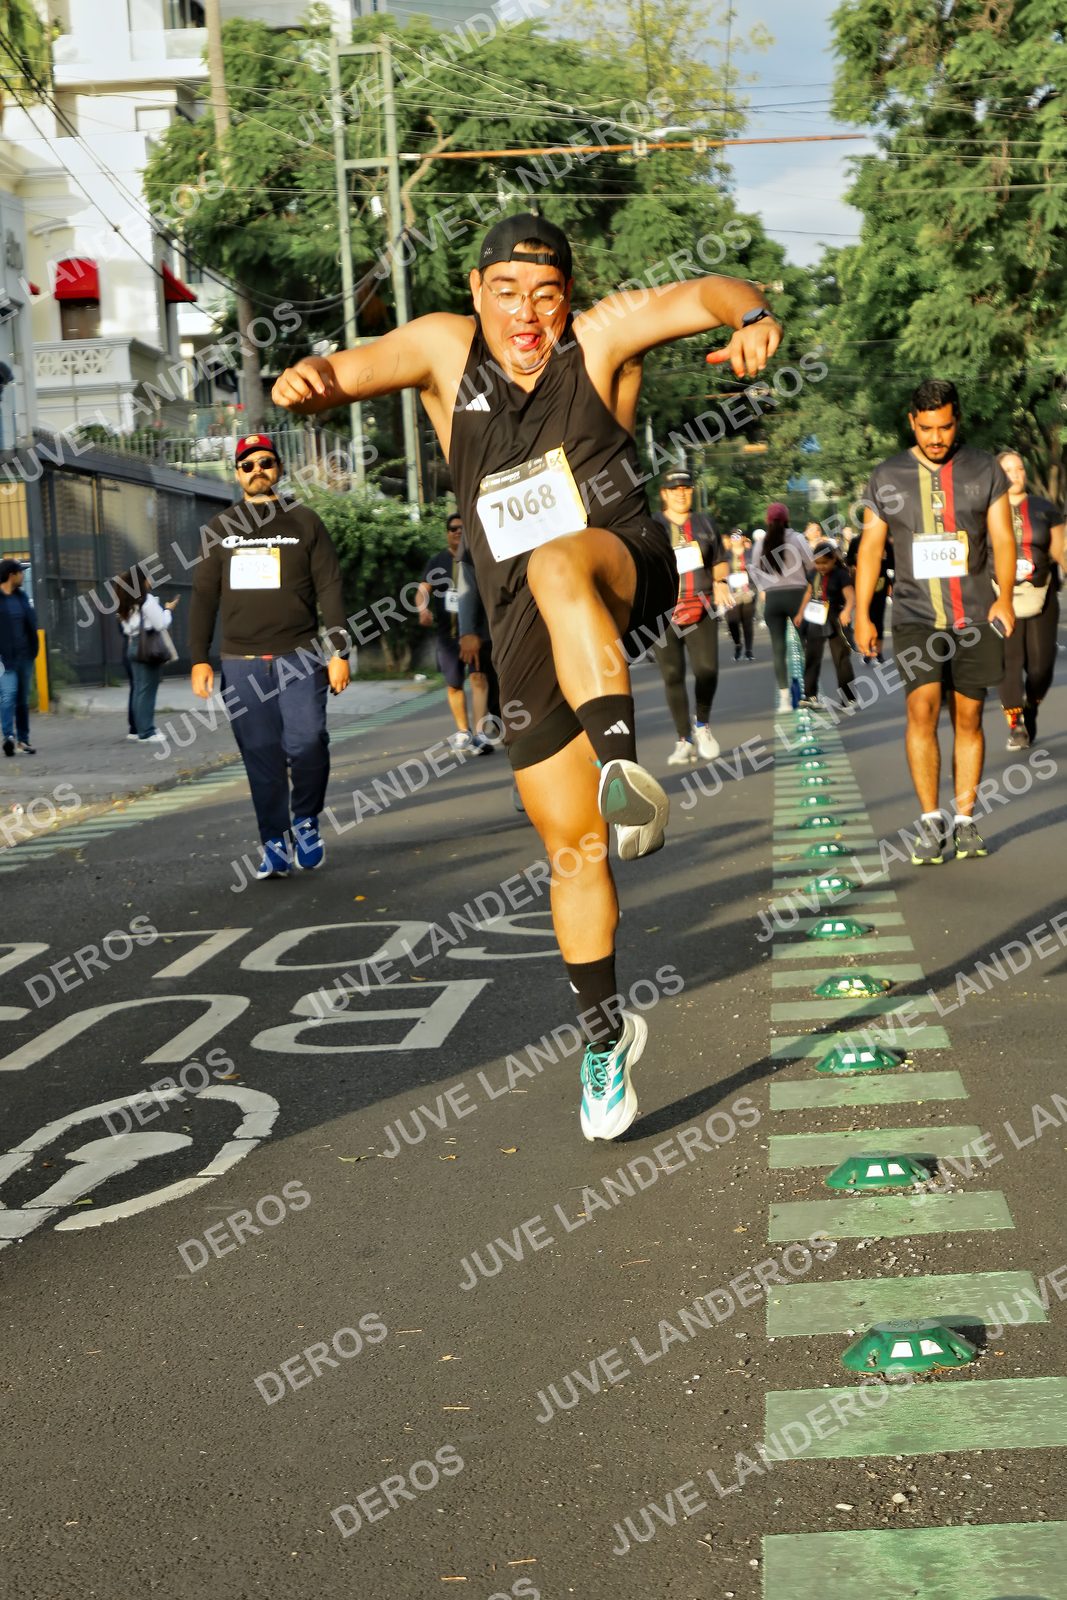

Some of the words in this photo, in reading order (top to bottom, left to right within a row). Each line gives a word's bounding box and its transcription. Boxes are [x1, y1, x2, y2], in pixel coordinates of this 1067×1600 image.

[490, 484, 557, 528] 7068
[222, 535, 300, 548] Champion
[0, 911, 561, 978] SOL
[0, 979, 494, 1071] BU
